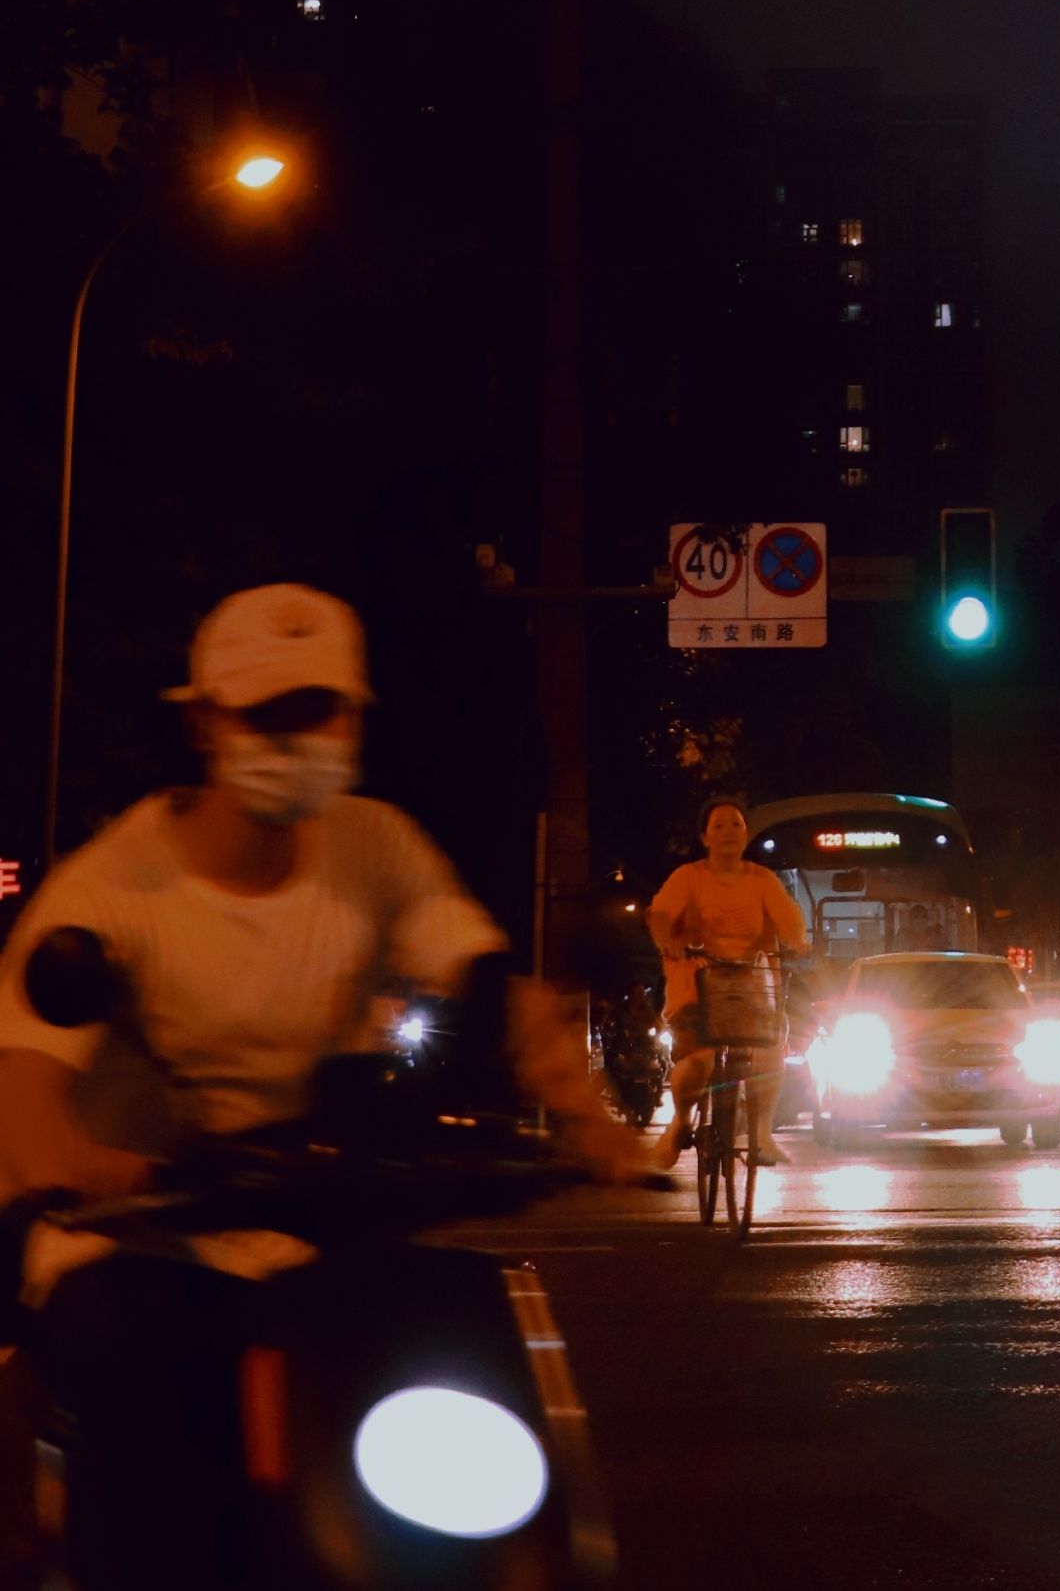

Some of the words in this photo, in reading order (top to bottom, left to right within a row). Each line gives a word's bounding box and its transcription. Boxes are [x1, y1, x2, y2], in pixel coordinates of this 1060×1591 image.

[686, 542, 727, 580] 40
[696, 623, 794, 642] 东安南路
